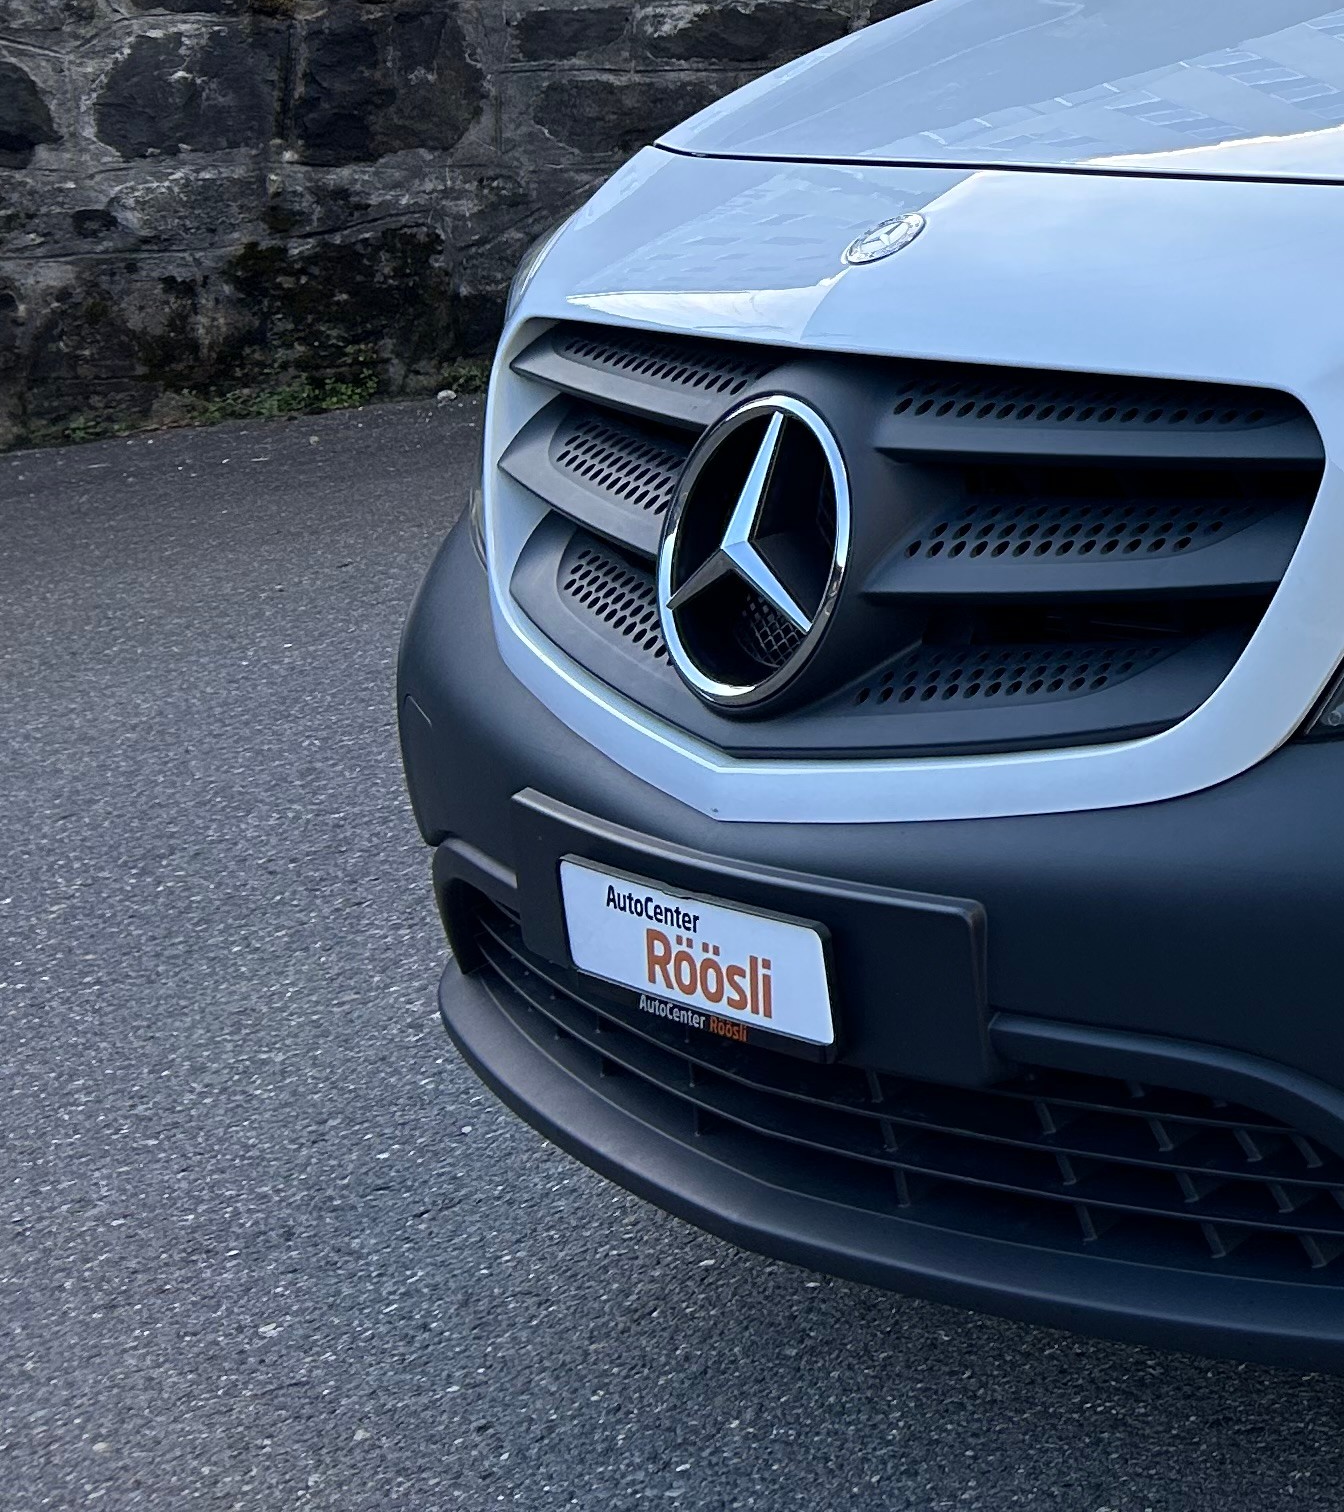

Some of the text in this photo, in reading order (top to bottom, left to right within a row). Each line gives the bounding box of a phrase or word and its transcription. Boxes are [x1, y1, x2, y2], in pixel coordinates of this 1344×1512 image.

[605, 885, 699, 933] AutoCenter
[645, 928, 772, 1019] Röösli
[639, 994, 750, 1042] AutoCenter Röösli
